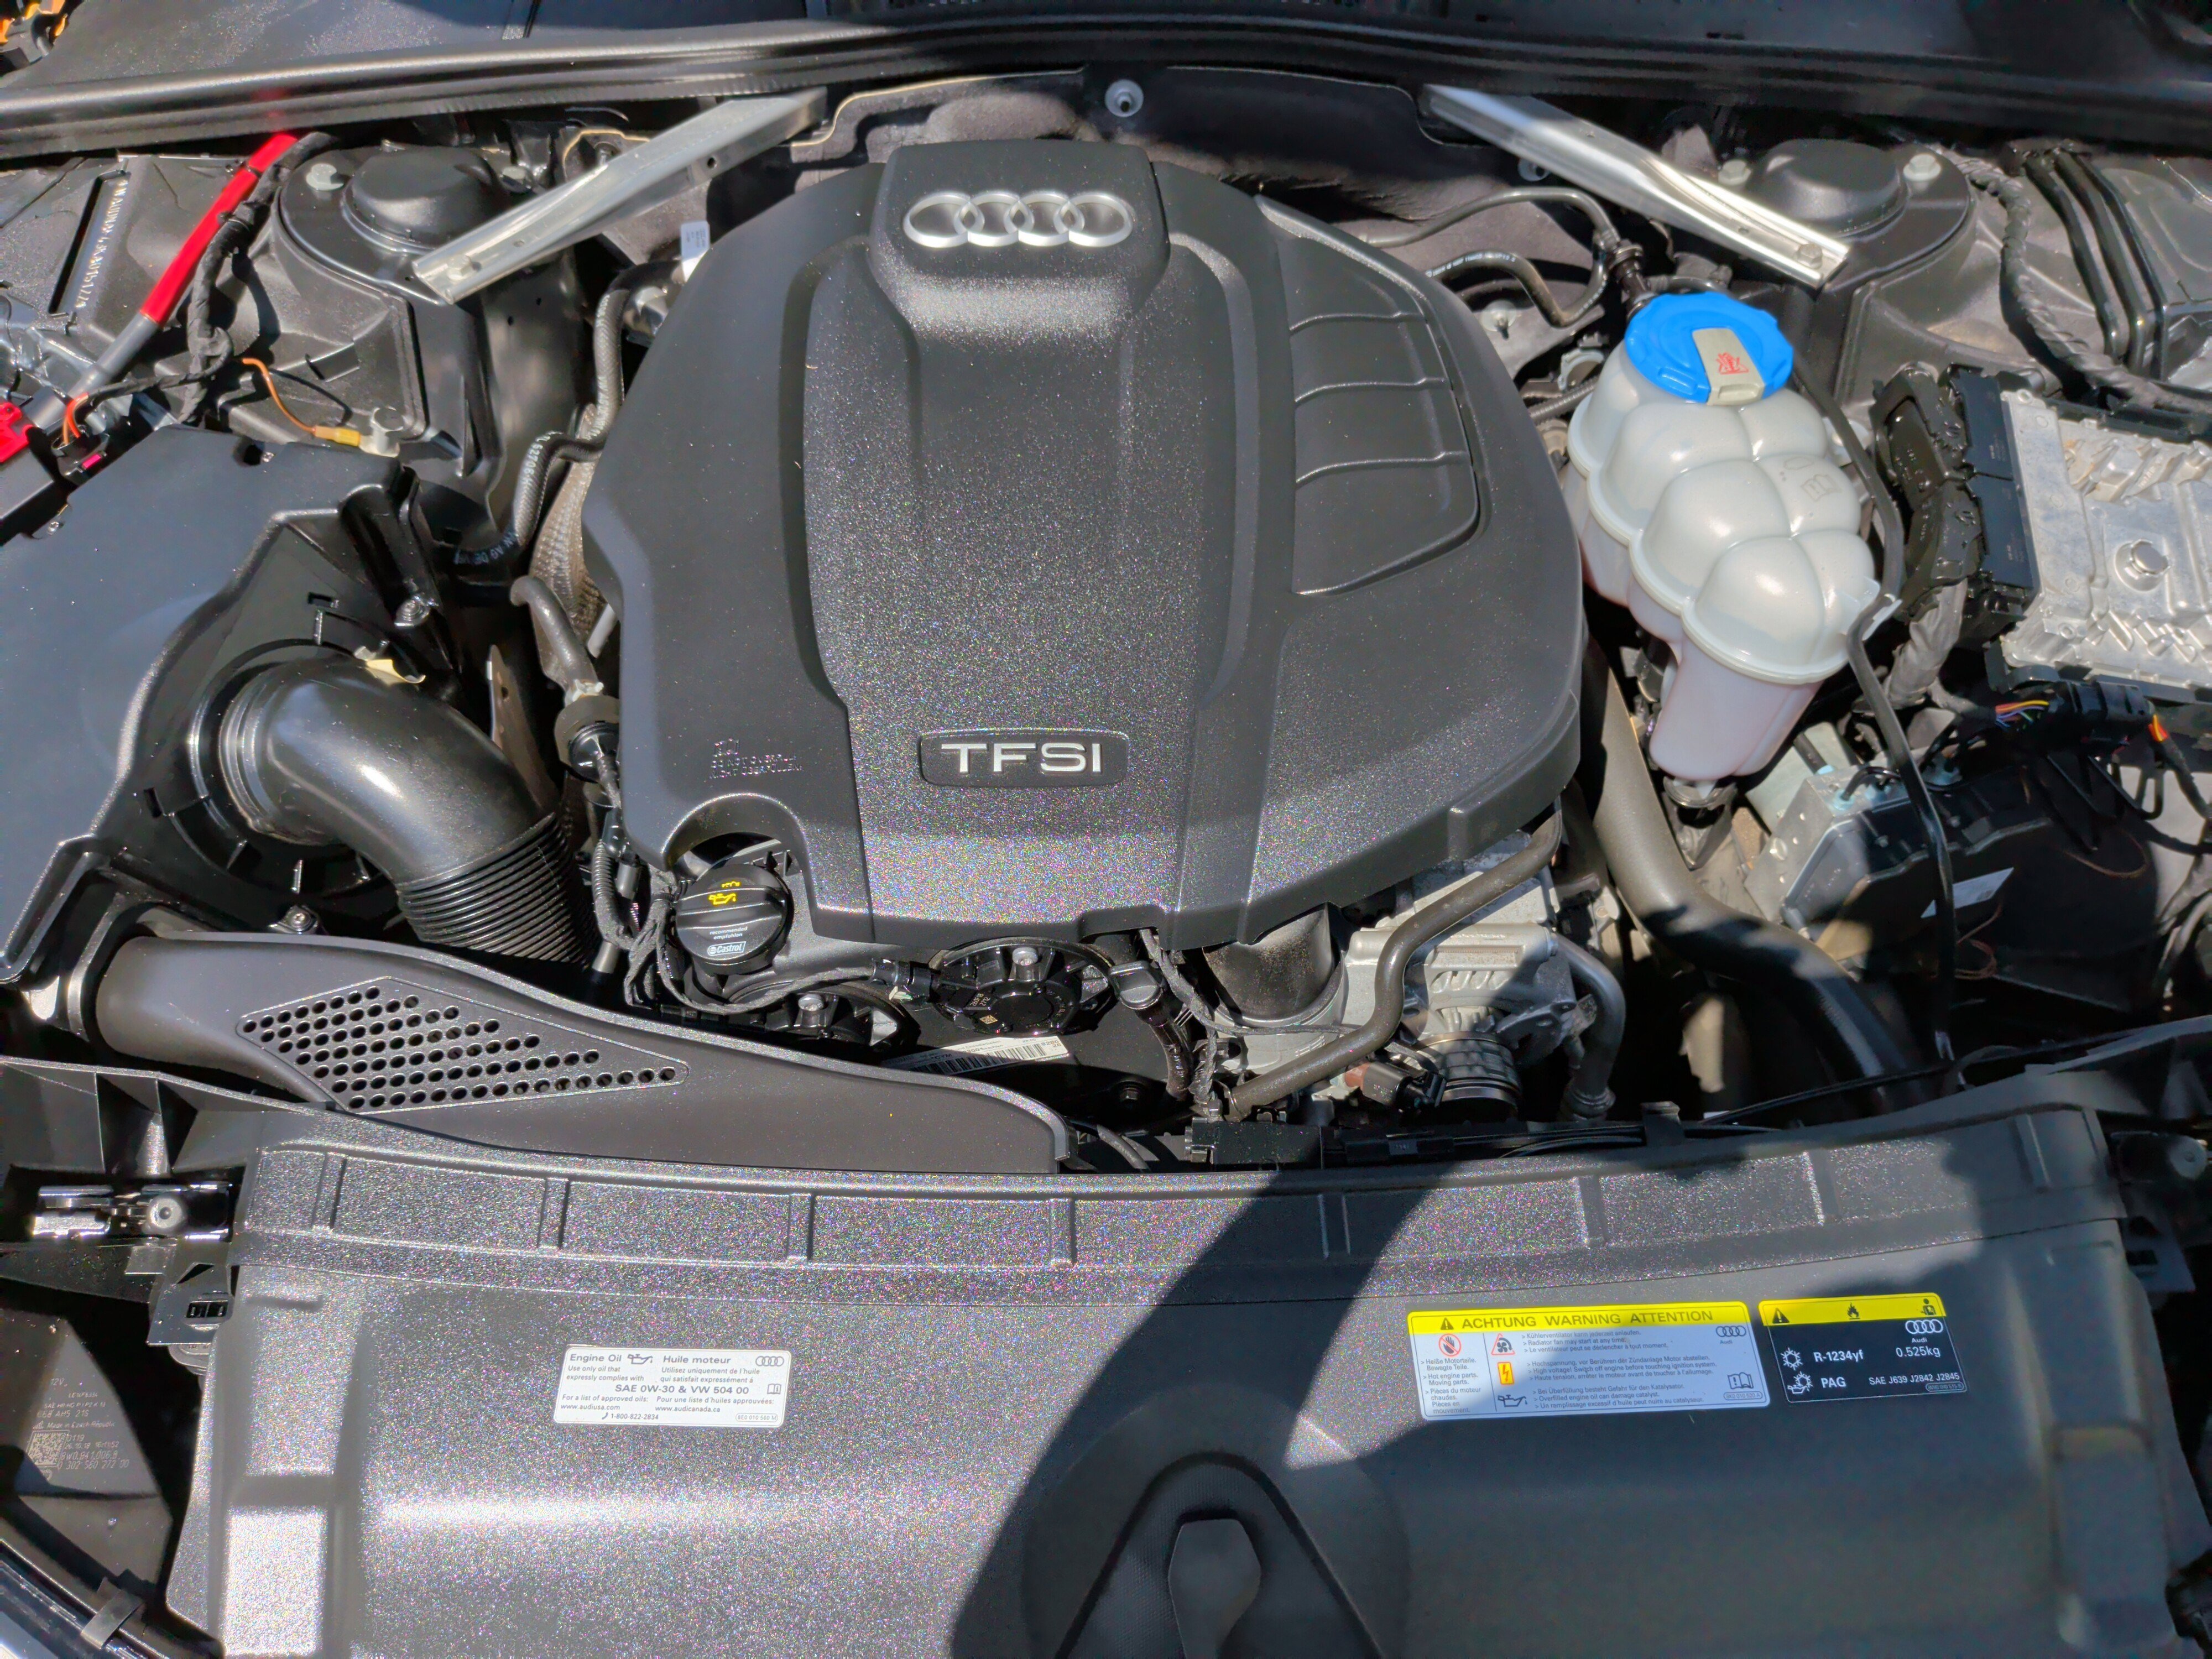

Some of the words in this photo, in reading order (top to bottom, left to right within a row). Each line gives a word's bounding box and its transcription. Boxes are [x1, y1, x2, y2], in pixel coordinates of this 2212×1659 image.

[941, 742, 1102, 773] TFSI
[709, 926, 748, 935] recommended
[717, 943, 742, 953] Castrol
[1462, 1316, 1536, 1329] ACHTUNG
[1545, 1313, 1621, 1326] WARNING
[1631, 1310, 1713, 1323] ATTENTION
[570, 1354, 604, 1363] Engine
[1813, 1349, 1864, 1363] R-1234yf
[1896, 1345, 1941, 1358] 0.525kg
[663, 1355, 688, 1364] Huile
[1821, 1376, 1846, 1389] PAG
[1869, 1376, 1886, 1385] SAE
[1888, 1375, 1908, 1384] J639
[1910, 1374, 1934, 1383] J2842
[1936, 1372, 1960, 1381] J2845
[615, 1384, 637, 1392] SAE
[640, 1385, 675, 1394] 0W-30
[678, 1385, 687, 1394] &
